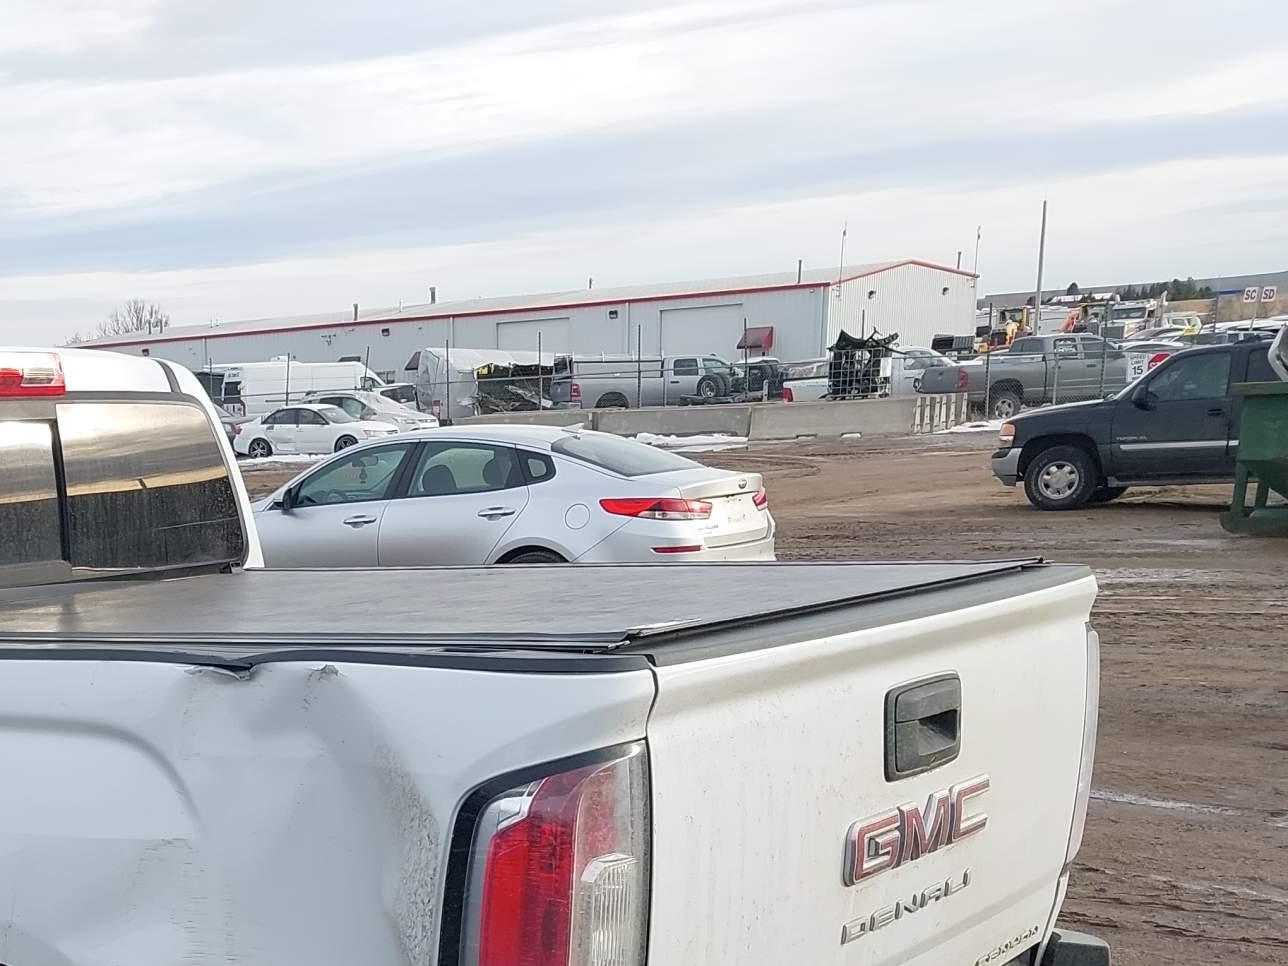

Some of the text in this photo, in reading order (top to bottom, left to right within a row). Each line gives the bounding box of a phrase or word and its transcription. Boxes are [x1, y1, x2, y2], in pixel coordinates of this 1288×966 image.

[1244, 288, 1257, 301] SC
[1263, 288, 1275, 300] SD
[1132, 365, 1144, 376] 15
[841, 773, 990, 886] GMC
[840, 868, 970, 945] DENALI
